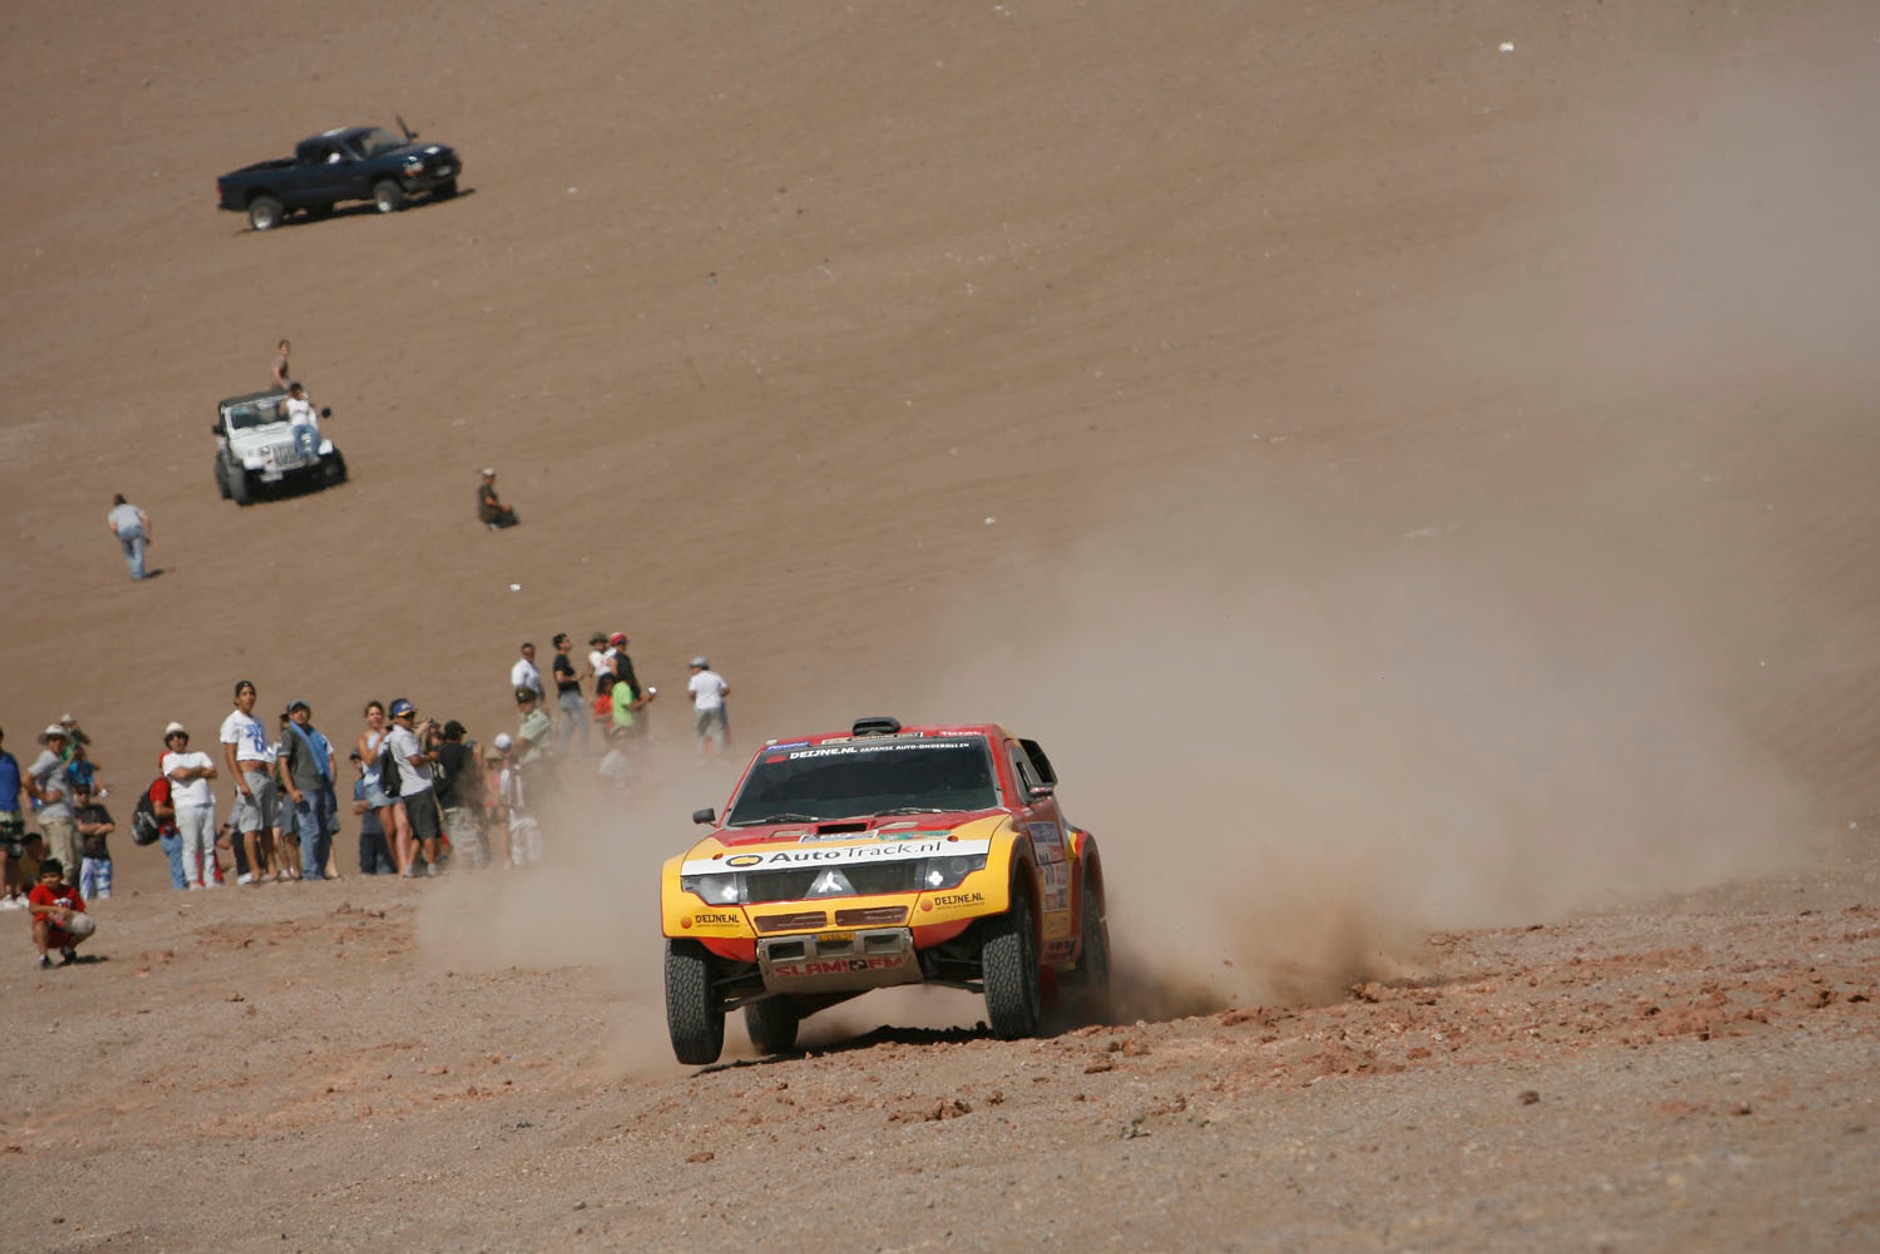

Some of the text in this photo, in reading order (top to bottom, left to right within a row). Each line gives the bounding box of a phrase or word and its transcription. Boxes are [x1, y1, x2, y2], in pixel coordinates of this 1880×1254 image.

[789, 746, 857, 760] DEIJNE.NL
[768, 842, 942, 863] AutoTrack.nl
[933, 892, 984, 906] DEIJNE.NL
[695, 914, 740, 924] DEIJNE.NL
